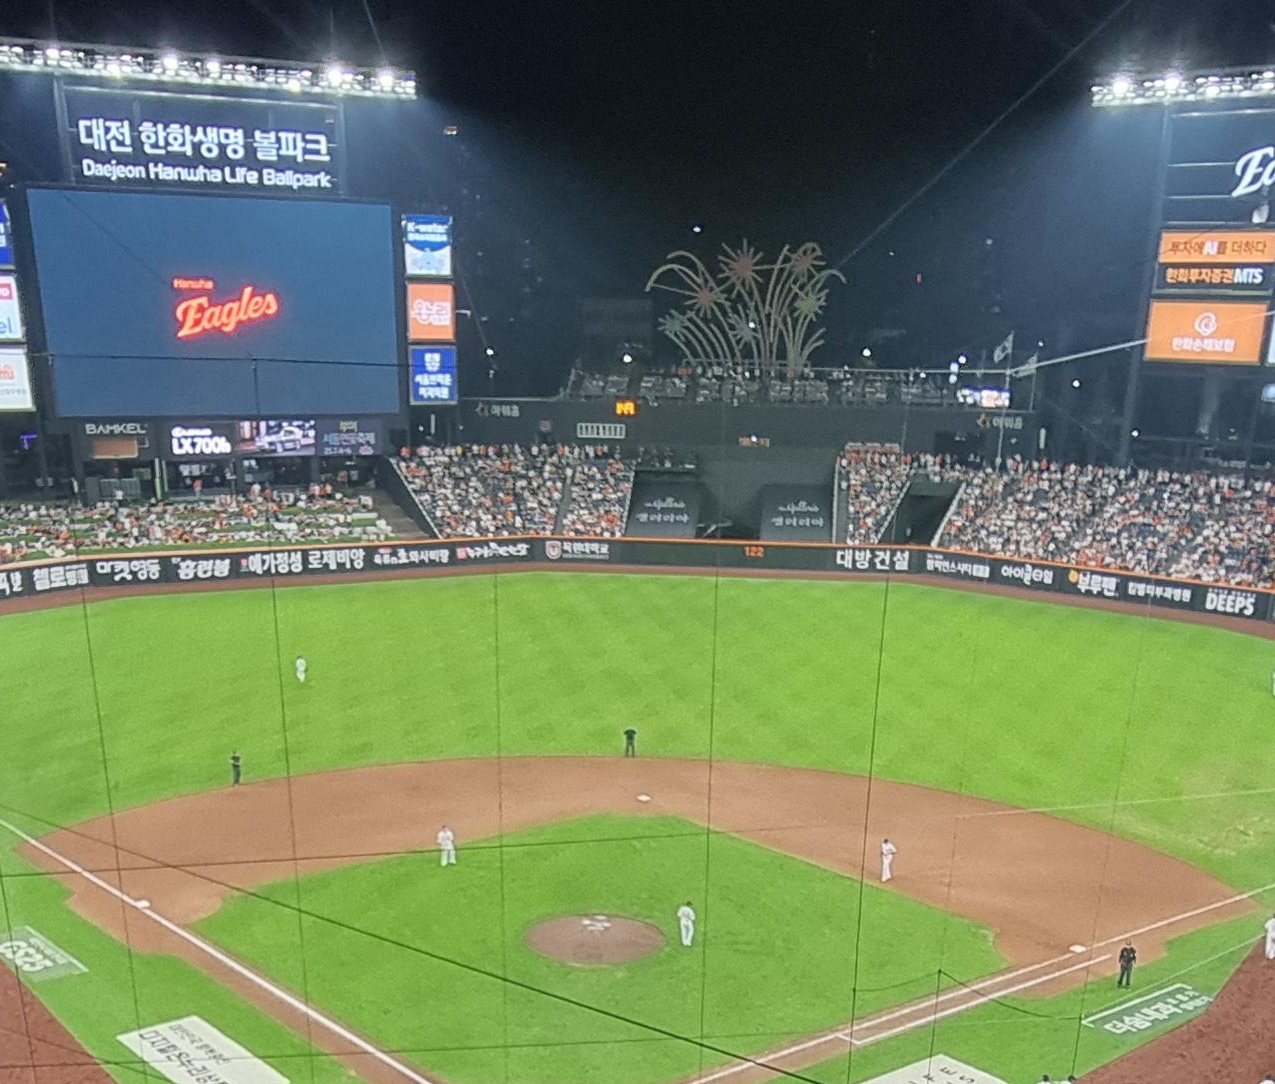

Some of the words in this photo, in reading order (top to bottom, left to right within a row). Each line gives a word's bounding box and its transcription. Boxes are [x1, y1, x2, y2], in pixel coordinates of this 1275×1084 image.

[78, 118, 132, 152] 대전
[139, 121, 245, 159] 한화생명
[253, 129, 331, 162] 볼파크
[82, 158, 146, 182] Daejeon
[148, 162, 222, 183] Hanwha
[224, 166, 258, 185] Life
[263, 168, 332, 190] Ballpark
[176, 286, 278, 338] Eagles
[836, 549, 910, 571] 대방건설
[1205, 591, 1256, 616] DEEPS
